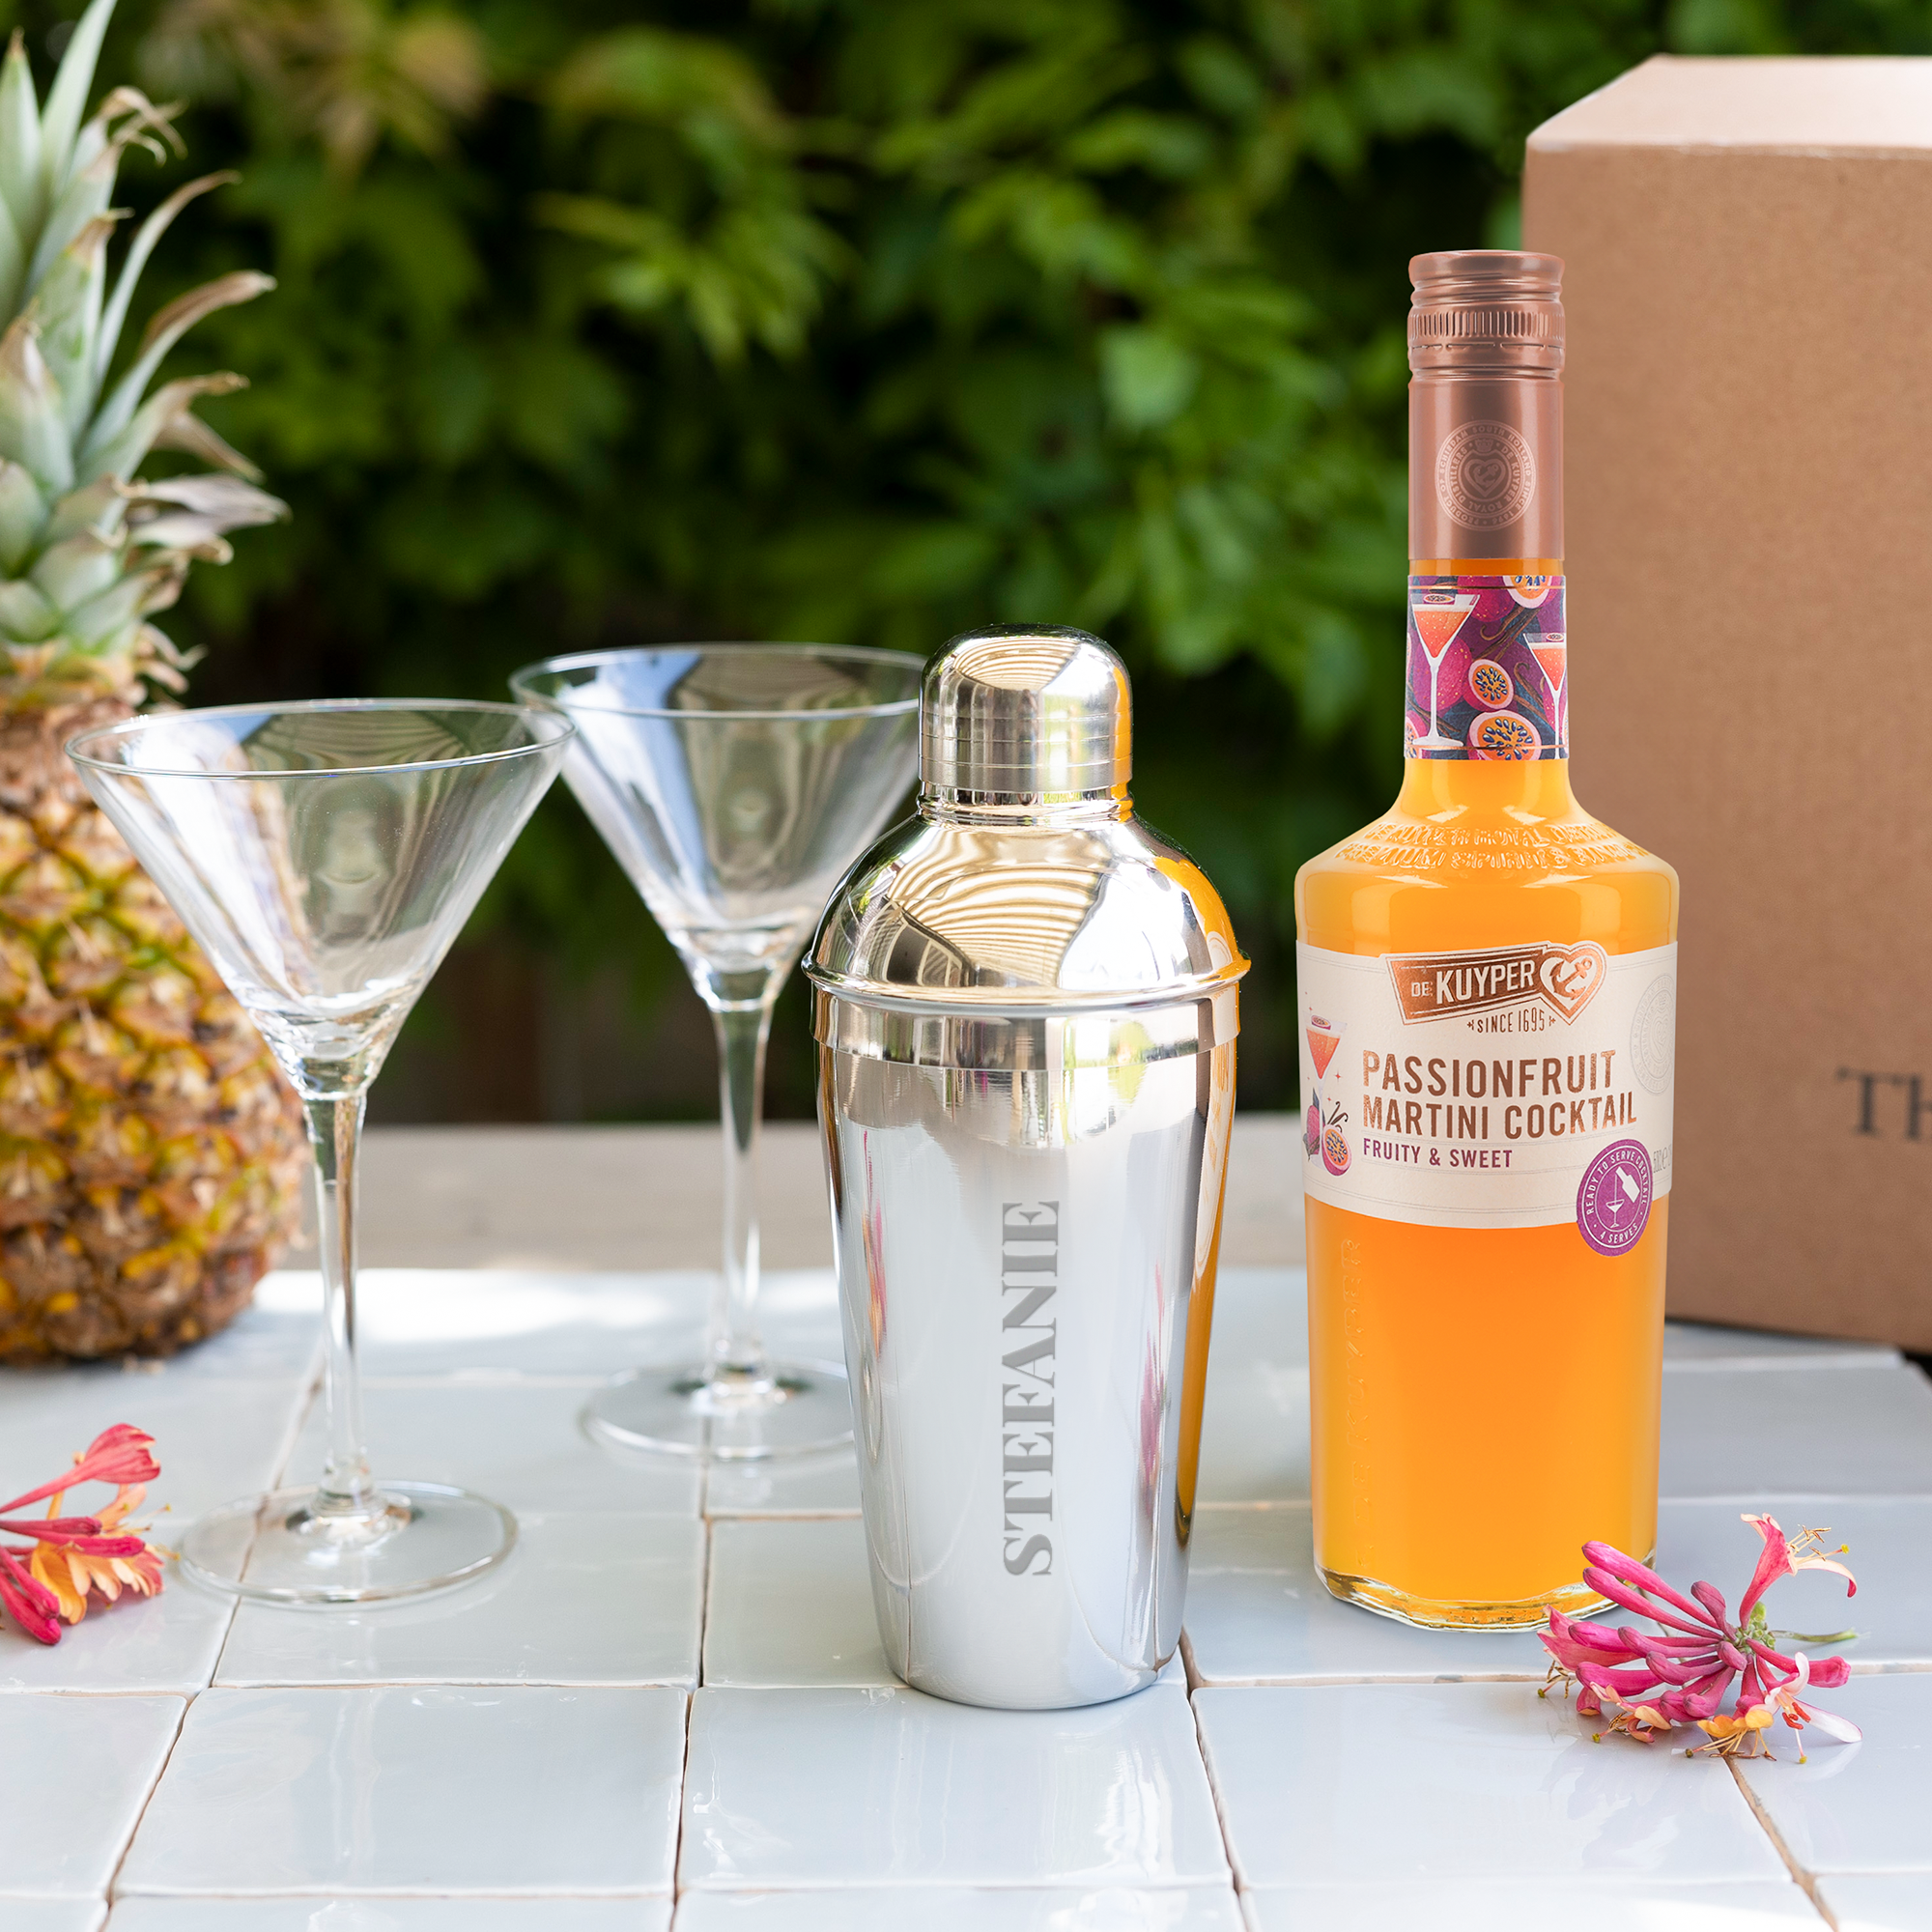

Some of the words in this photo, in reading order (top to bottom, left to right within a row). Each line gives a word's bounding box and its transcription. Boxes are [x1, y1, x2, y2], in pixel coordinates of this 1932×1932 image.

[1472, 425, 1505, 436] SOUTH
[1500, 446, 1515, 460] DE
[1508, 434, 1532, 476] HOLLAND
[1450, 446, 1468, 504] DISTILLERS
[1503, 462, 1520, 502] KUYPER
[1468, 500, 1503, 513] ROYAL
[1516, 481, 1531, 510] SINCE
[1411, 981, 1430, 997] DE
[1435, 959, 1536, 1005] KUYPER
[1477, 1012, 1514, 1034] SINCE
[1518, 1007, 1546, 1033] 1695
[1363, 1049, 1616, 1098] PASSIONFRUIT
[1363, 1094, 1489, 1140] MARTINI
[1504, 1091, 1637, 1140] COCKTAIL
[1363, 1138, 1421, 1164] FRUITY
[1429, 1148, 1441, 1166] &
[1449, 1150, 1513, 1168] SWEET
[1585, 1177, 1600, 1215] READY
[1597, 1161, 1608, 1175] TO
[1610, 1150, 1636, 1164] SERVE
[1634, 1155, 1648, 1204] COCKTAIL
[1600, 1231, 1606, 1240] 4
[1607, 1222, 1638, 1244] SERVES
[1002, 1200, 1060, 1577] STEFANIE
